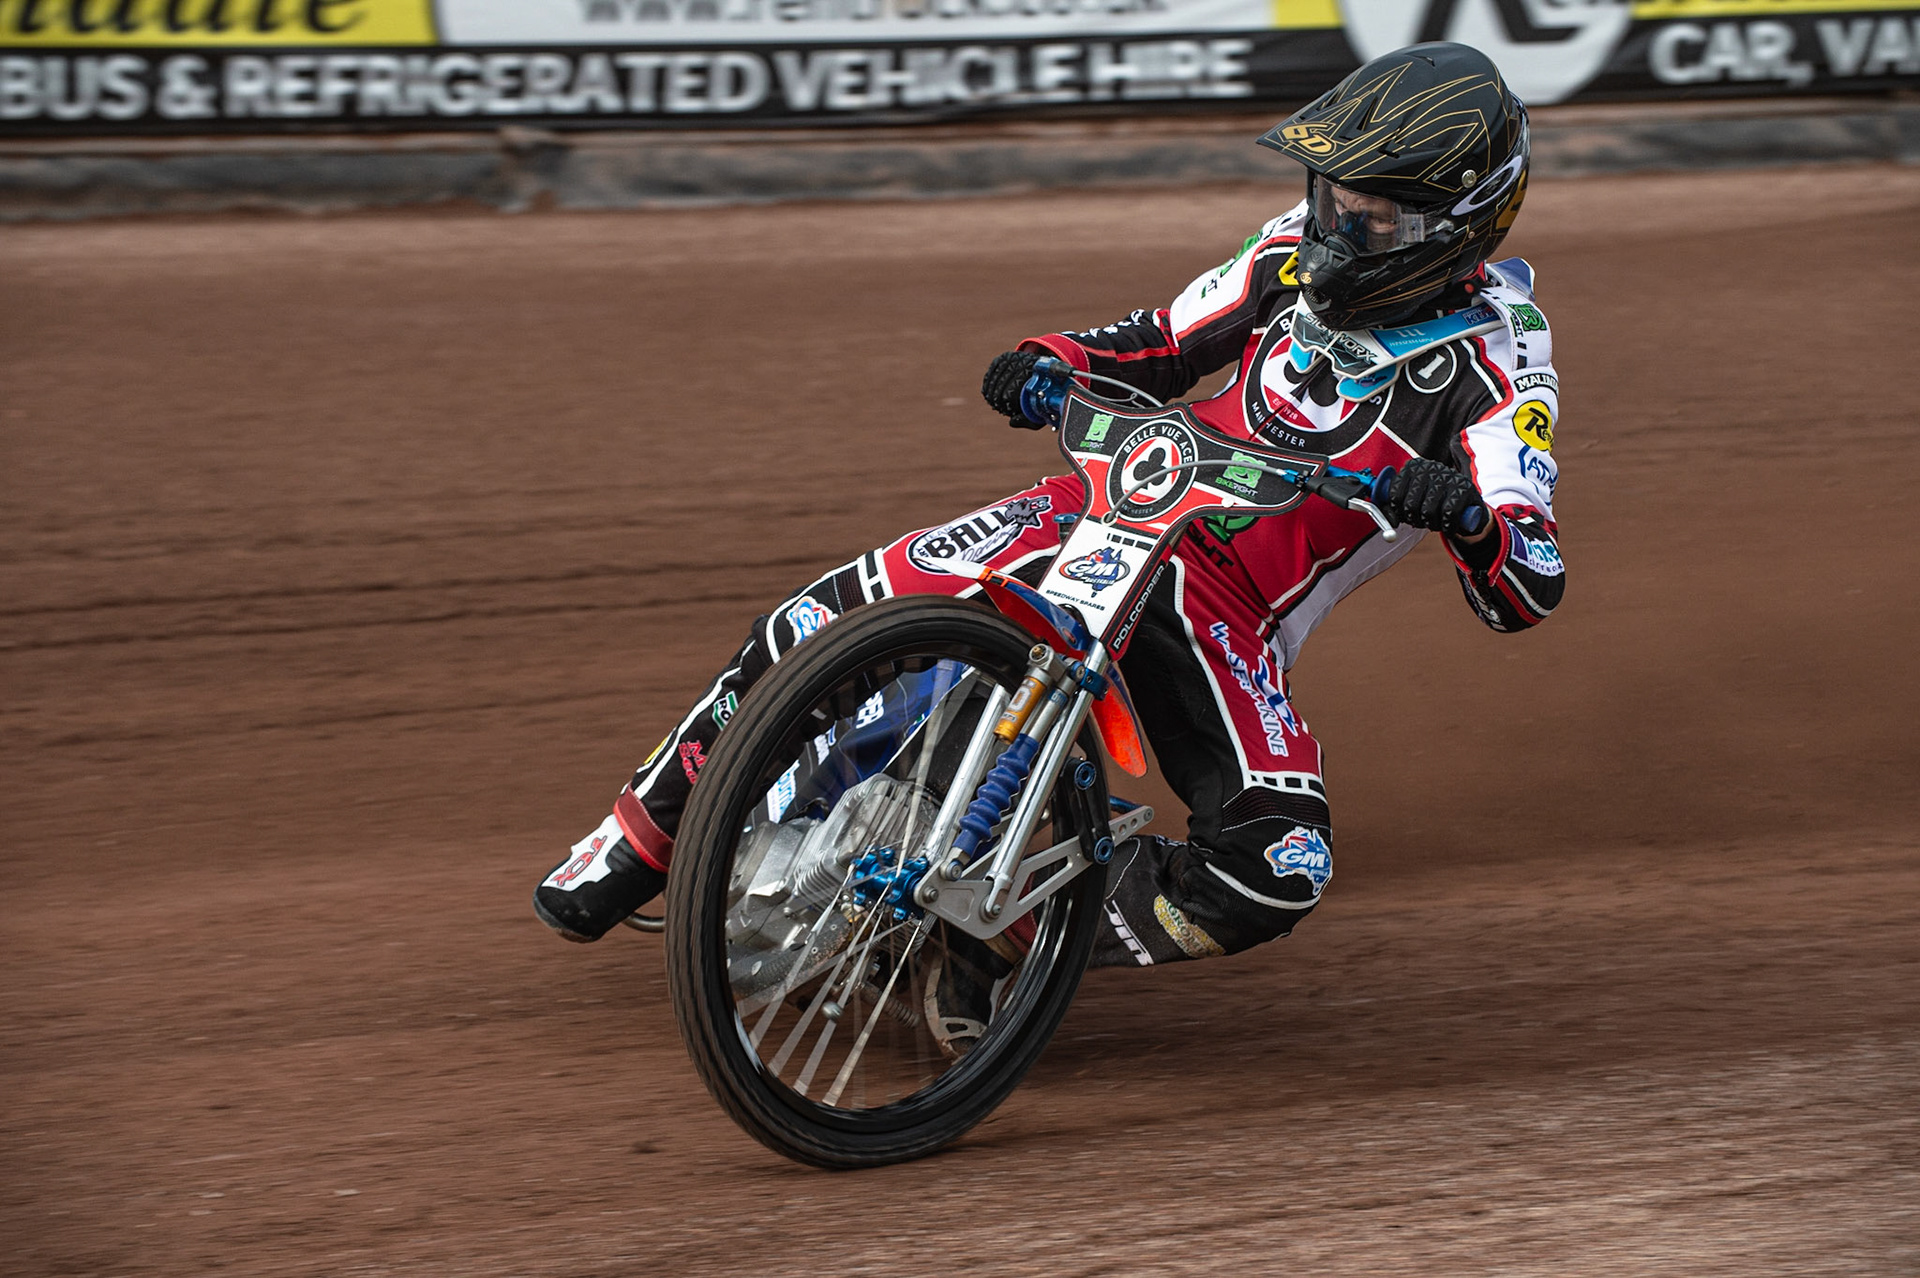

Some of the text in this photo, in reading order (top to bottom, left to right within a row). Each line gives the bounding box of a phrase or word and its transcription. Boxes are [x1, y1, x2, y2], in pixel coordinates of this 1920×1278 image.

[1650, 17, 1920, 87] CAR, VA
[0, 56, 149, 120] BUS
[158, 57, 214, 118] &
[224, 50, 765, 117] REFRIGERATED
[772, 44, 1083, 110] VEHICLE
[1123, 426, 1156, 454] BELLE
[1161, 425, 1182, 441] VUE
[1067, 559, 1118, 577] GM
[1045, 589, 1106, 612] SPEEDWAY SPARES
[1113, 564, 1165, 650] POLCOPPER
[1277, 847, 1327, 868] GM
